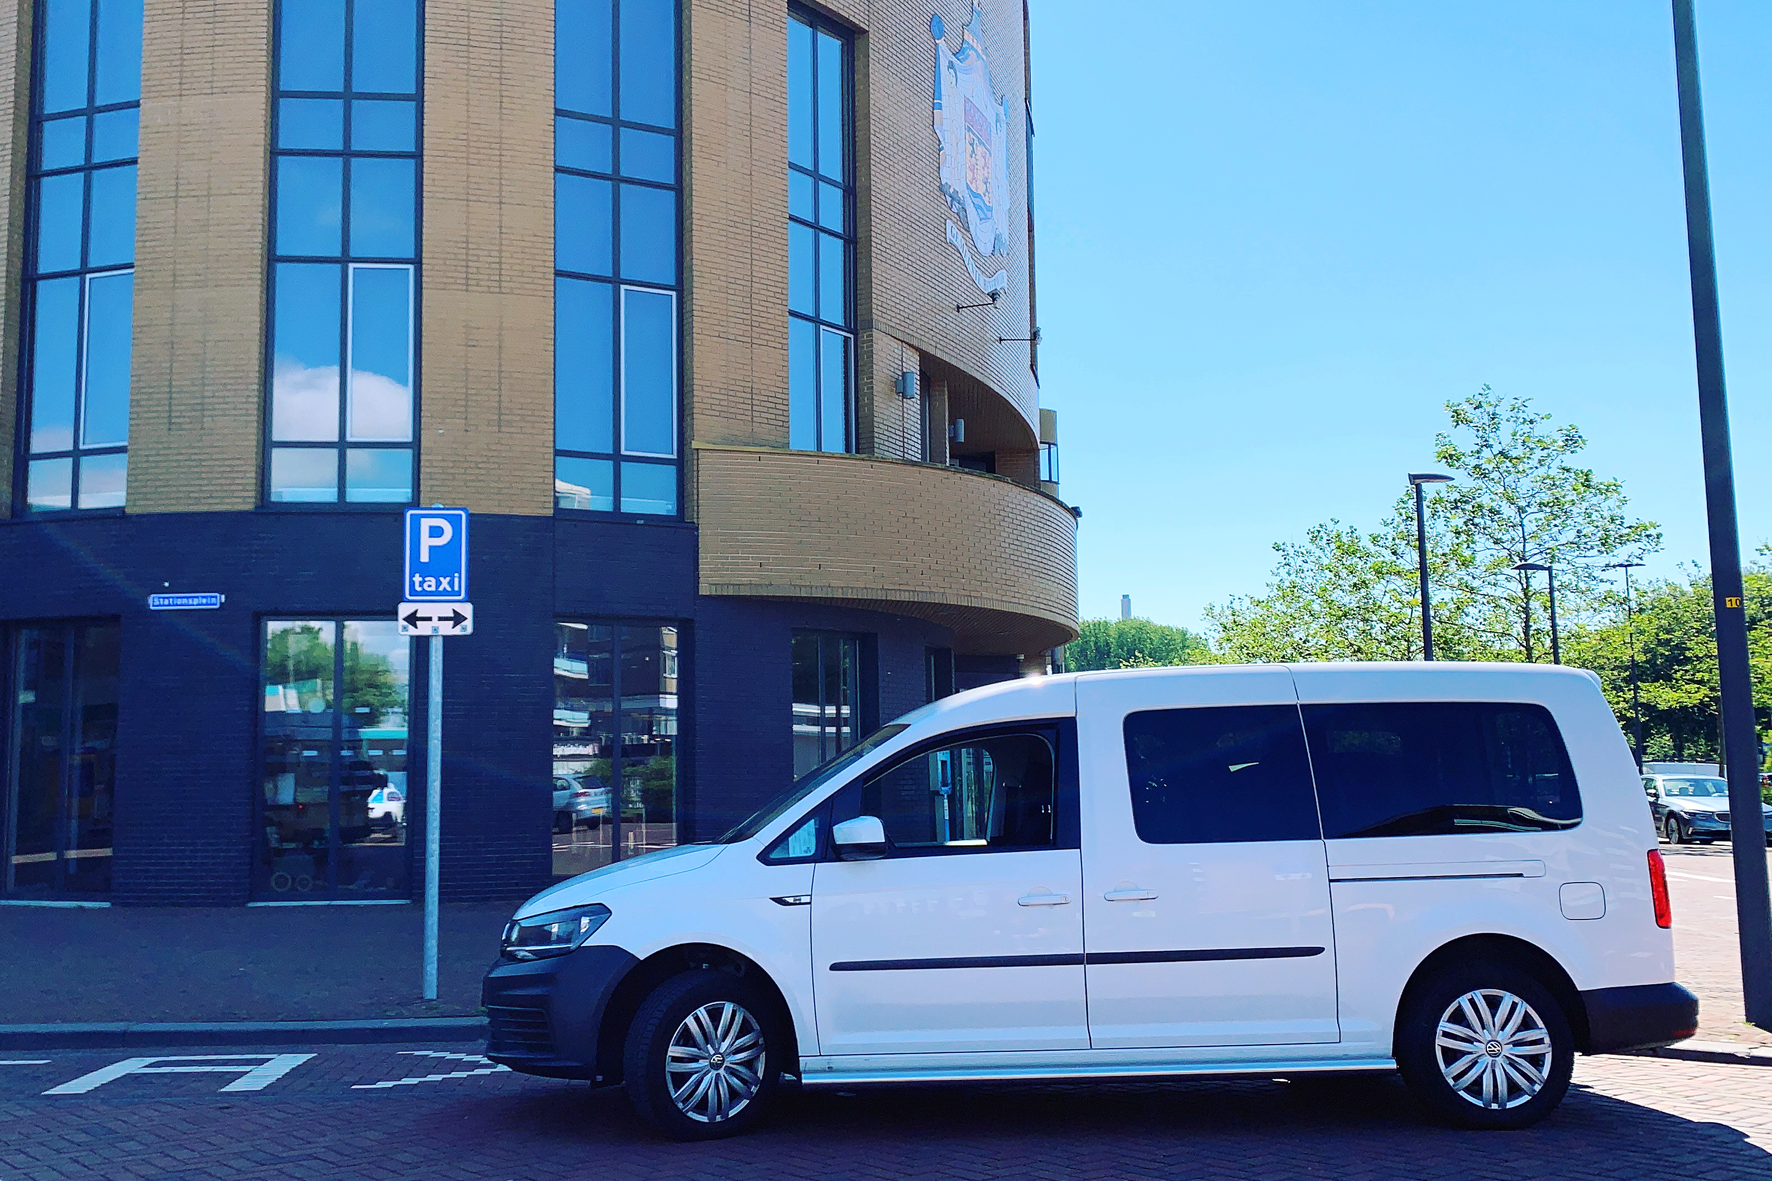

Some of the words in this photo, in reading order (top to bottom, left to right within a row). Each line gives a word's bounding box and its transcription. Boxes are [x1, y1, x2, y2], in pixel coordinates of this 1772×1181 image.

[420, 517, 453, 563] P
[412, 573, 460, 592] taxi
[153, 595, 217, 606] Stationsplein
